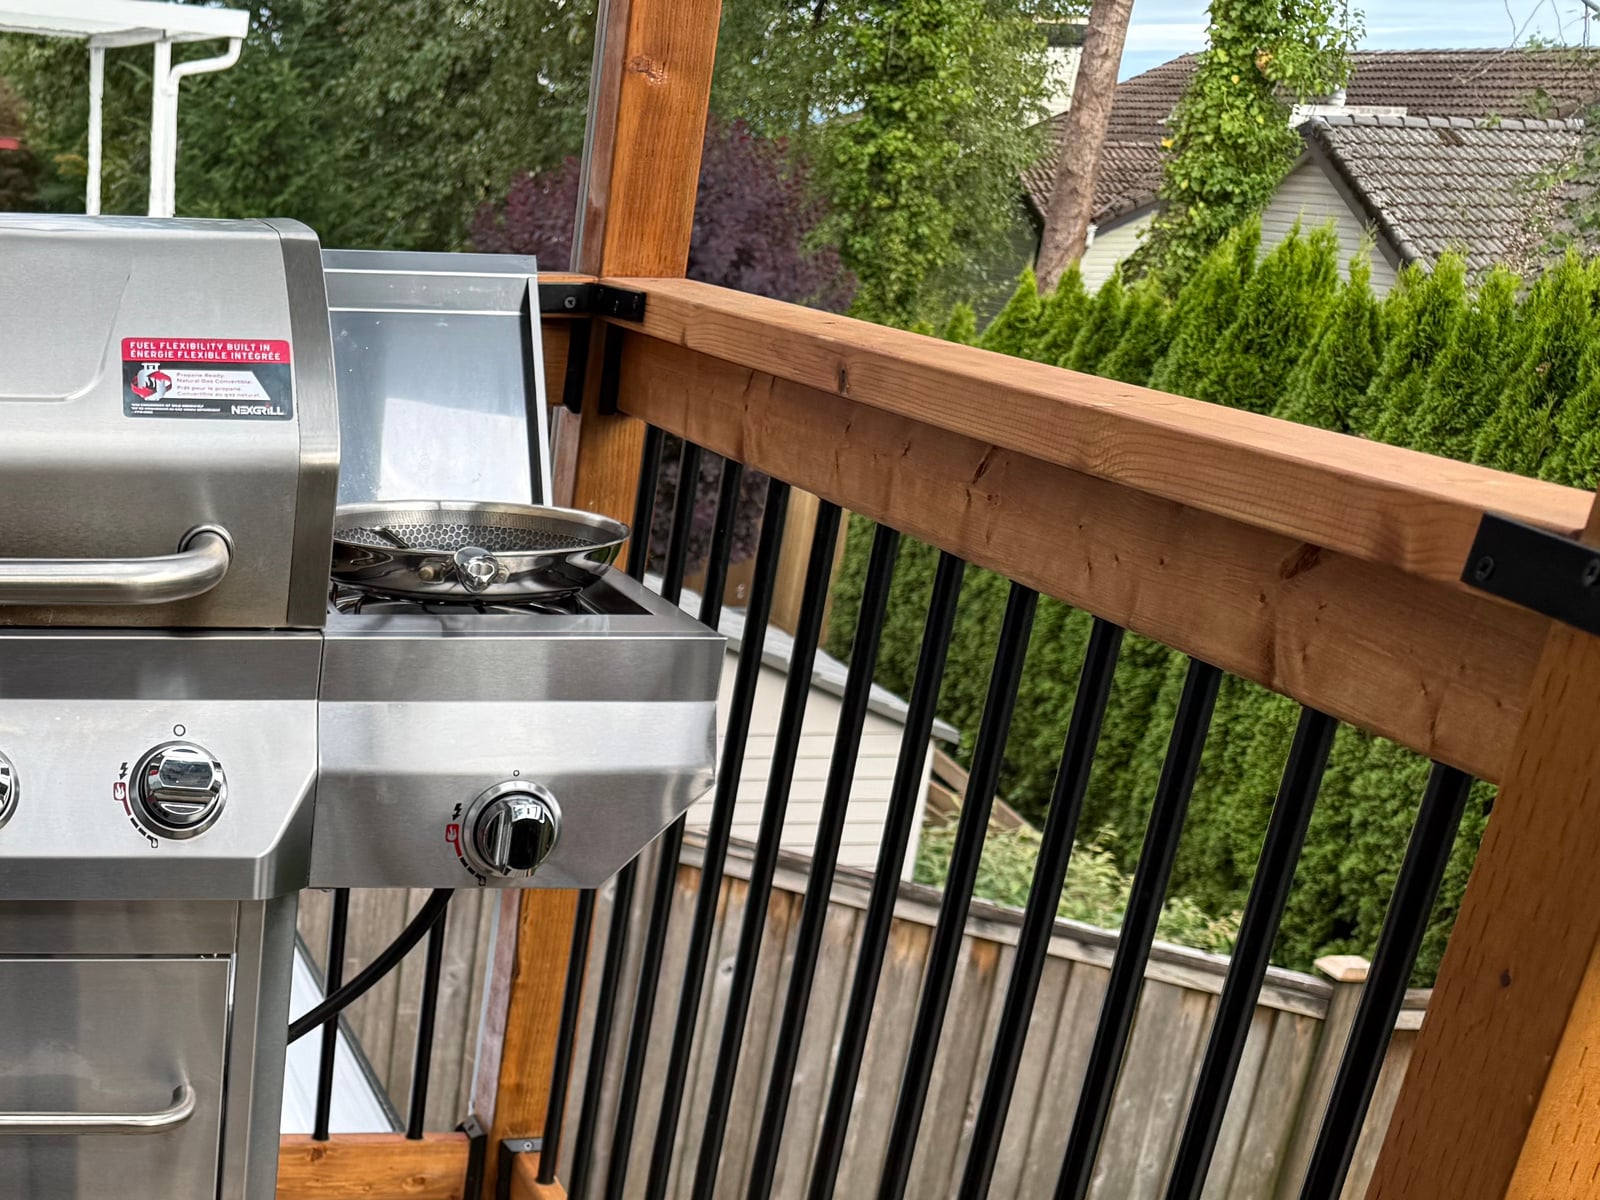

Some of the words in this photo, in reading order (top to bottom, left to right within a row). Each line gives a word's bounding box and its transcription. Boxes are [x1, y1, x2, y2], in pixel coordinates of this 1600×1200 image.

[129, 341, 158, 350] FUEL
[159, 342, 223, 351] FLEXIBILITY
[227, 343, 254, 351] BUILT
[259, 343, 271, 351] IN
[130, 350, 174, 359] ÉNERGIE
[177, 351, 228, 360] FLEXIBLE
[231, 351, 281, 361] INTÉGRÉE
[231, 404, 284, 416] NEXGRILL
